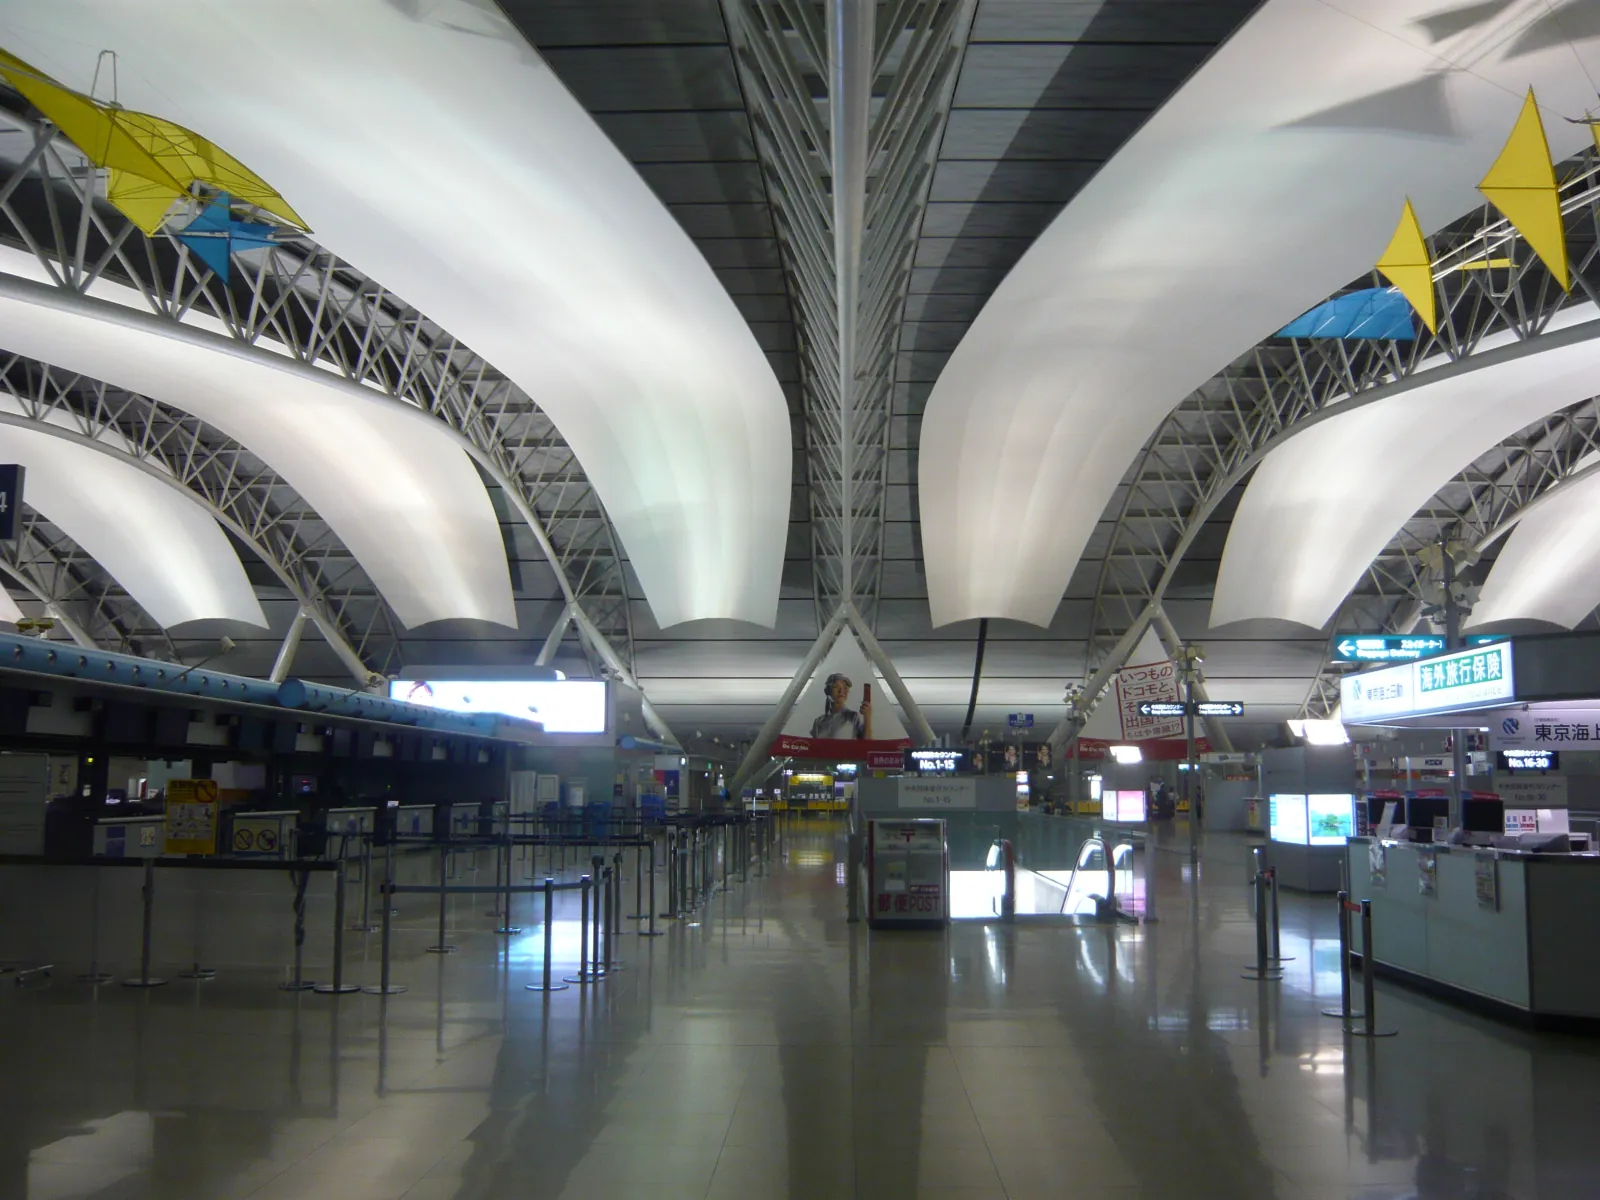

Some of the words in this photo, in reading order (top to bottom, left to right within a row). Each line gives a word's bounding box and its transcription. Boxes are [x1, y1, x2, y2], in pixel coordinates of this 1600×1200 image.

[1120, 666, 1173, 683] いつもの
[1420, 651, 1501, 691] 海外旅行保険
[1122, 682, 1174, 699] ドコモと、
[919, 759, 955, 770] No.1-15
[1508, 758, 1549, 769] No.16-30
[909, 895, 940, 914] POST
